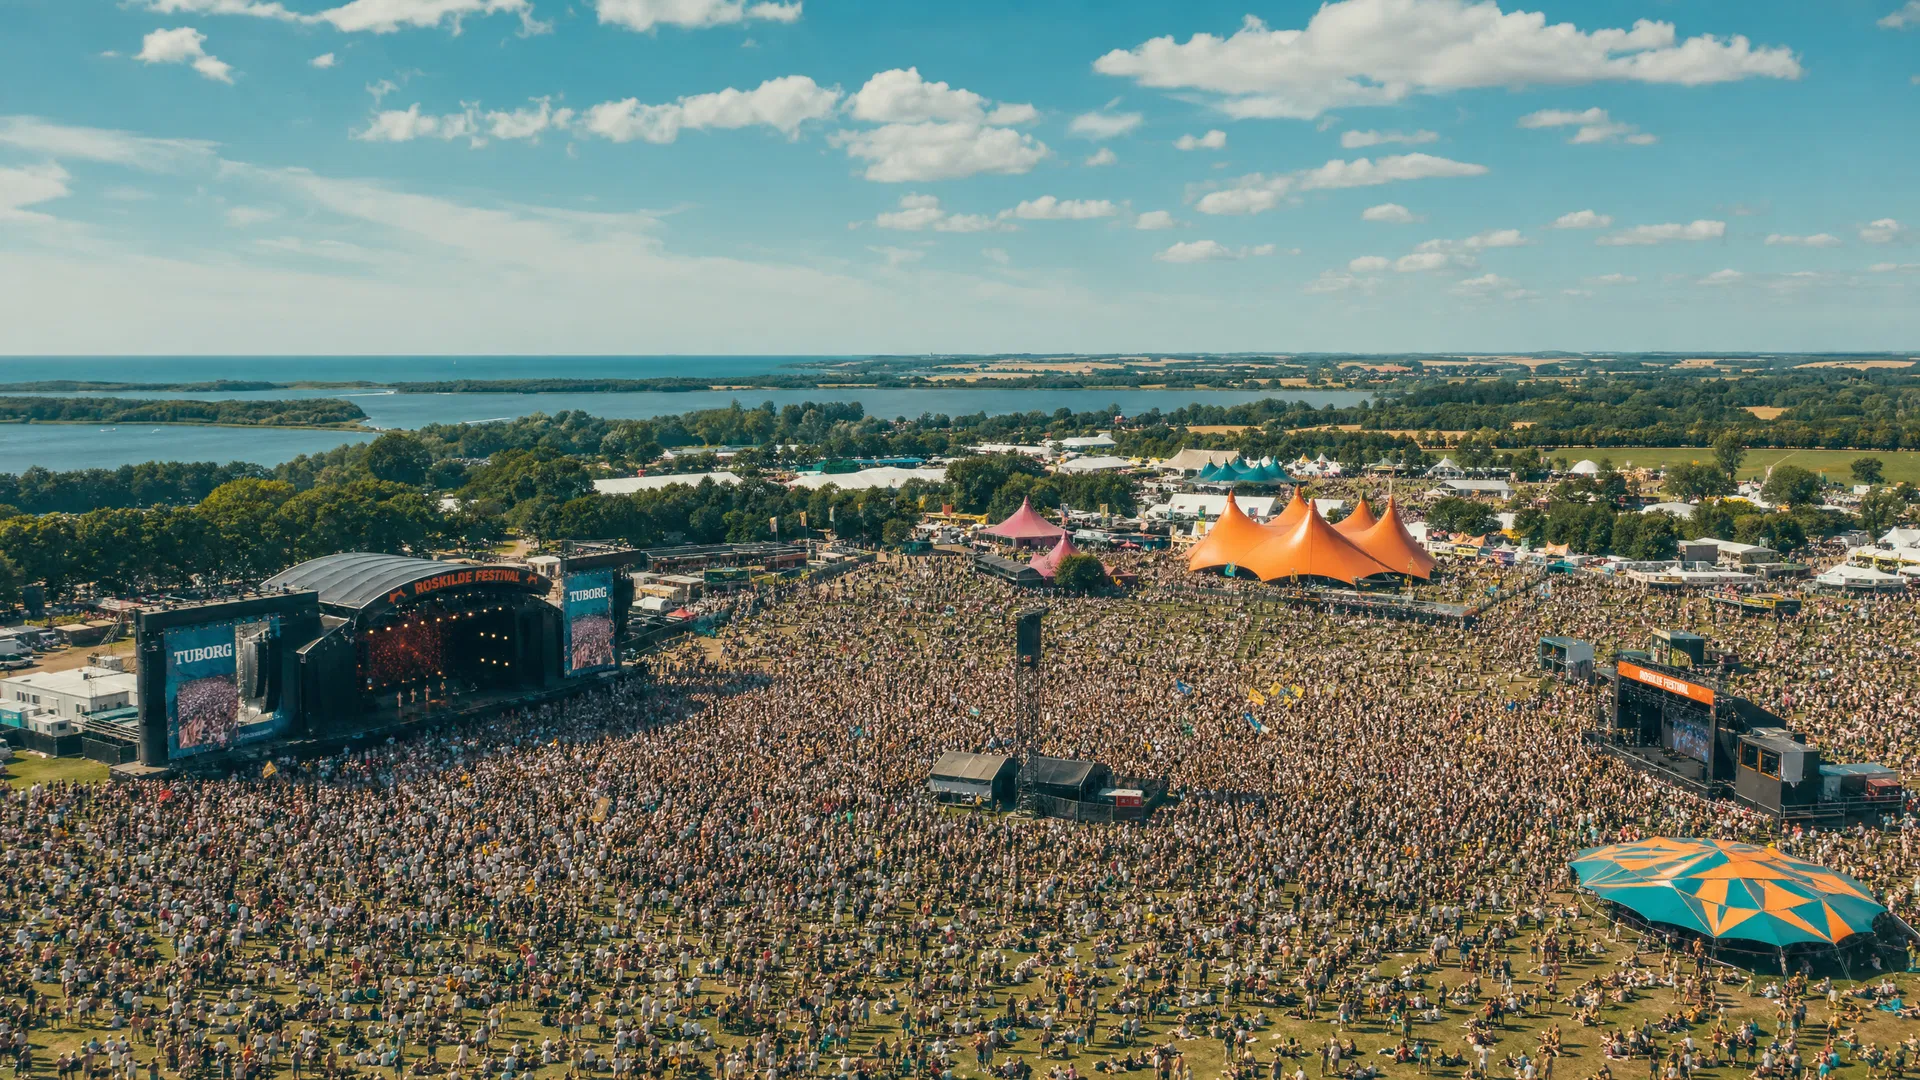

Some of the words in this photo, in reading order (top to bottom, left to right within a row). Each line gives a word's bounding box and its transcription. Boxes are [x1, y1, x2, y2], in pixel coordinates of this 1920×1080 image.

[414, 571, 472, 594] ROSKILDE
[475, 569, 520, 582] FESTIVAL
[569, 586, 607, 603] TUBORG
[173, 643, 232, 665] TUBORG
